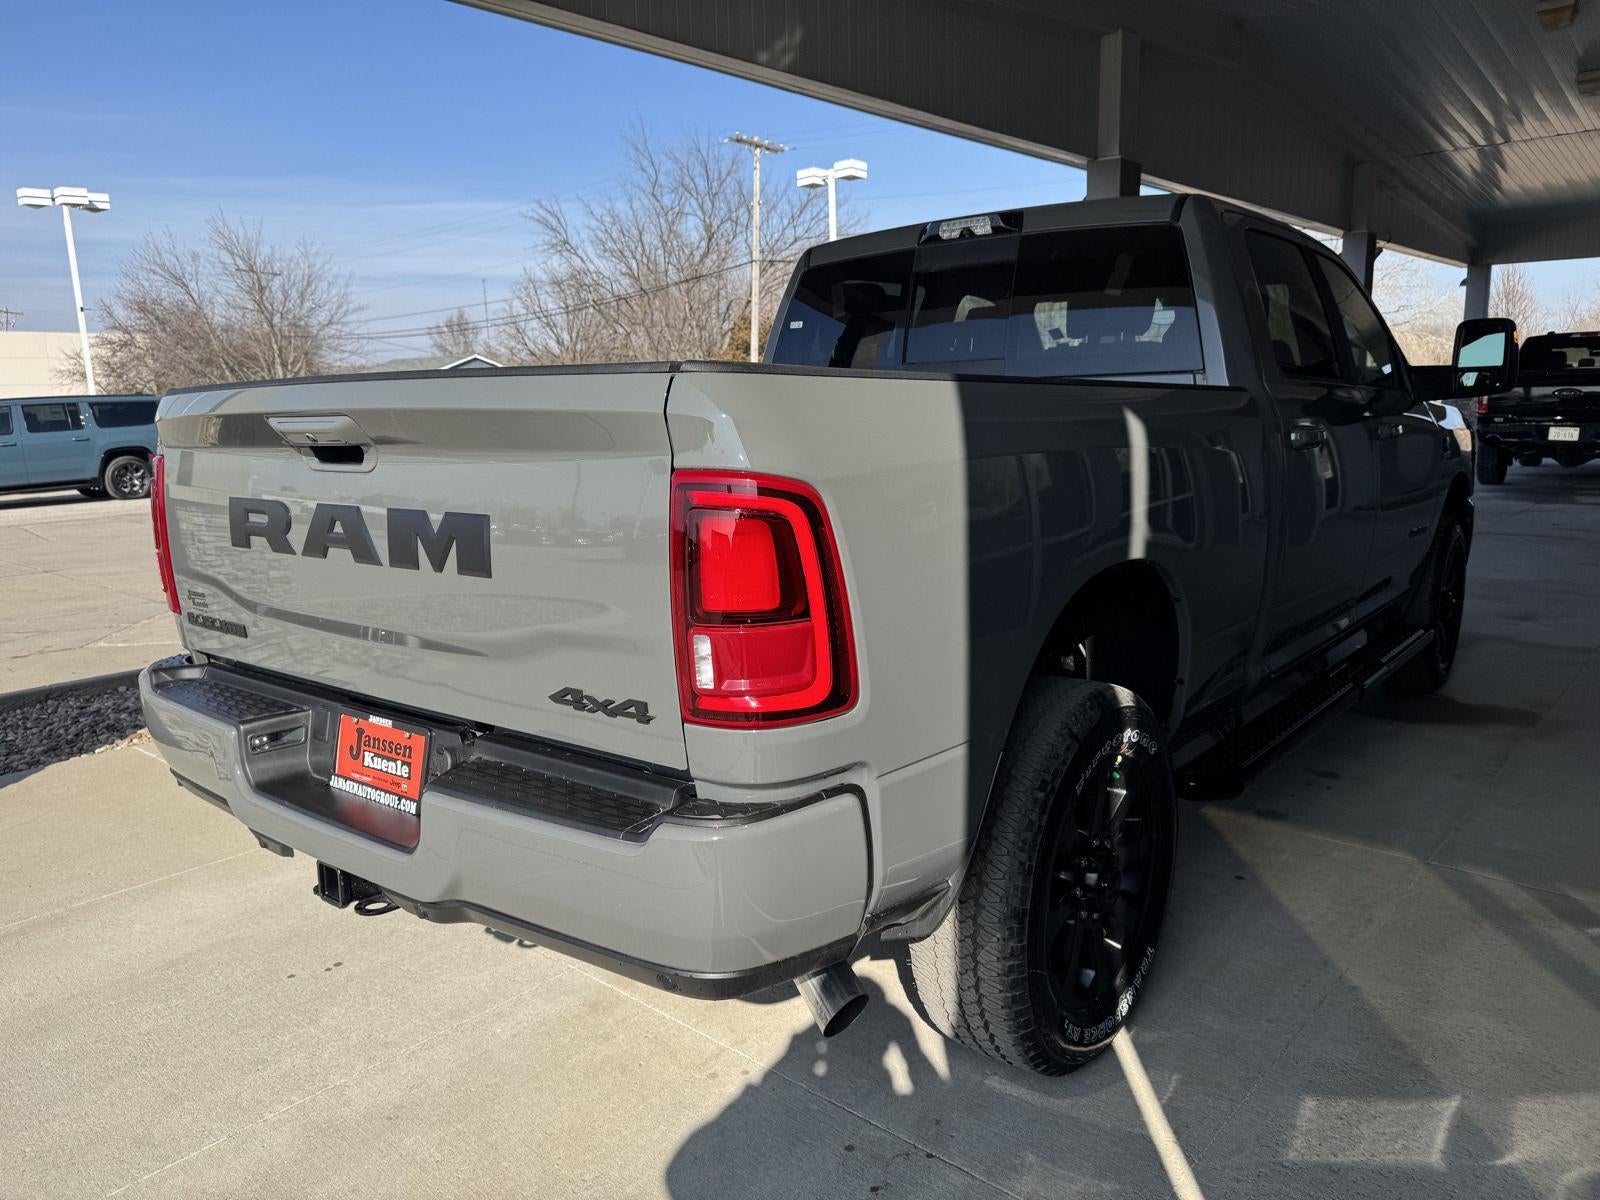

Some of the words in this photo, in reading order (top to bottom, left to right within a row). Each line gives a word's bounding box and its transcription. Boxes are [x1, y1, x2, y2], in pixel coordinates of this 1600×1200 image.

[229, 496, 492, 579] RAM
[349, 727, 412, 760] Janssen
[363, 751, 409, 777] Kuenle
[329, 774, 417, 815] JANSSENAUTOGROUP.COM
